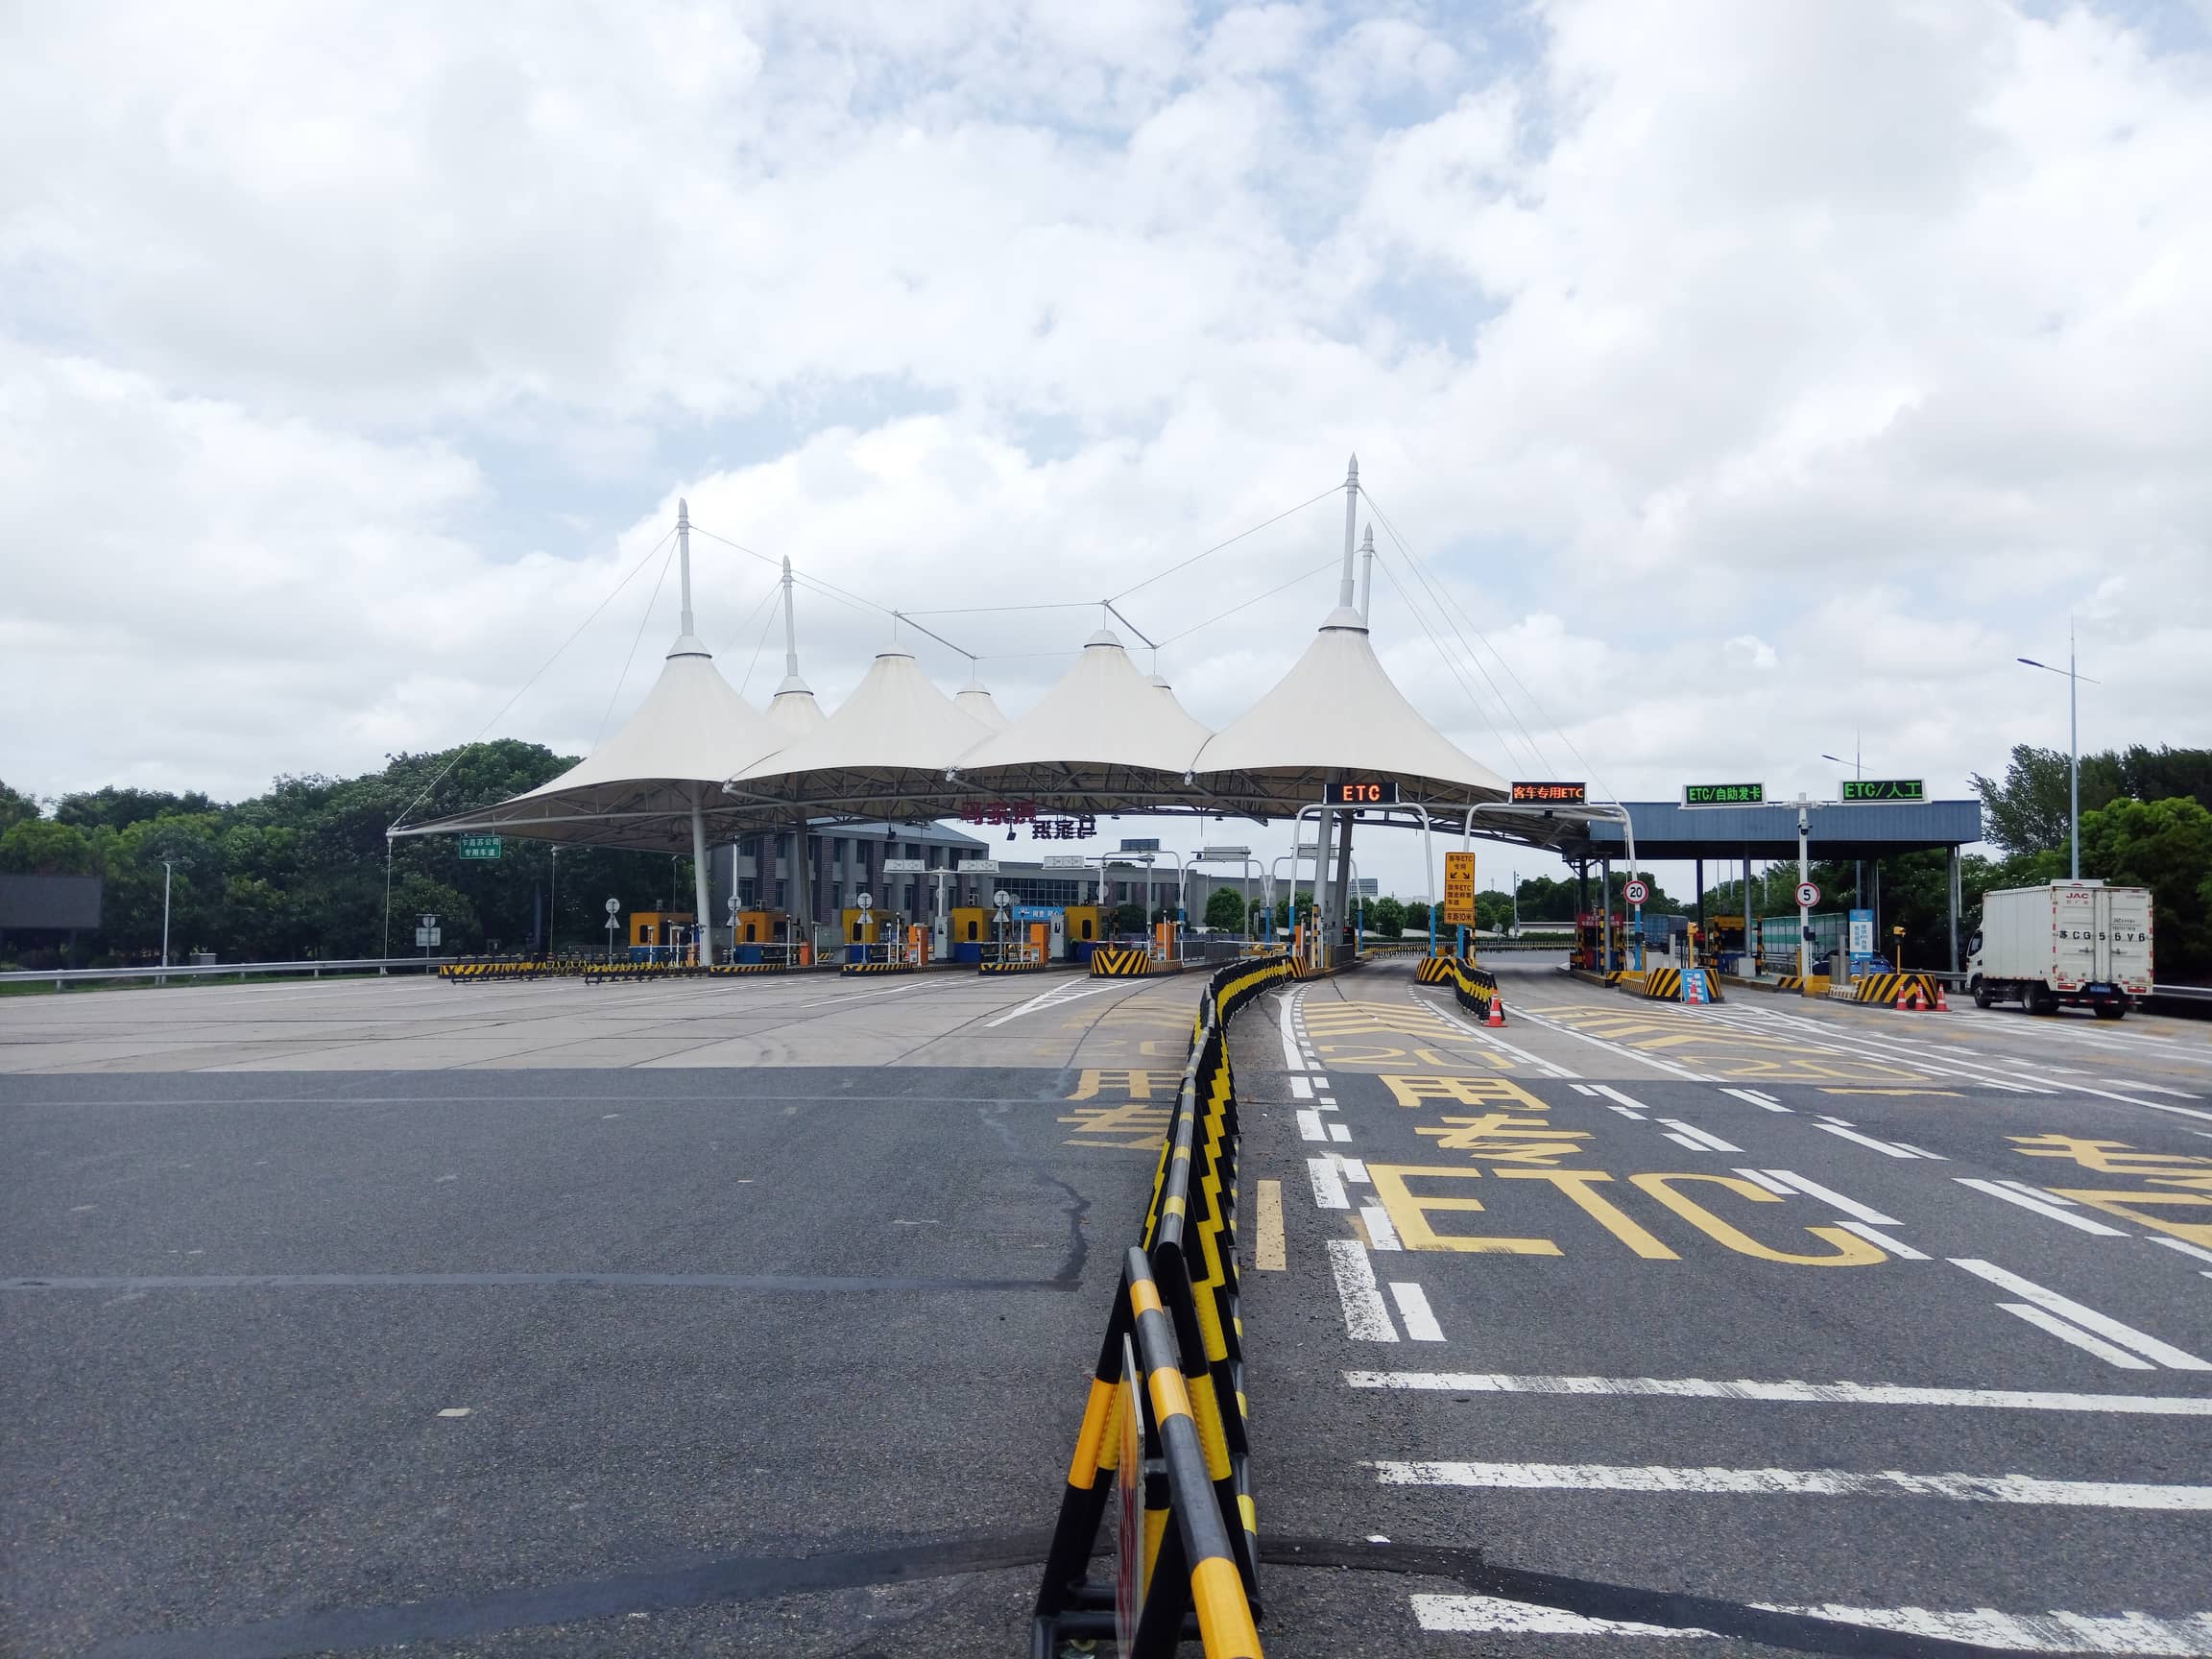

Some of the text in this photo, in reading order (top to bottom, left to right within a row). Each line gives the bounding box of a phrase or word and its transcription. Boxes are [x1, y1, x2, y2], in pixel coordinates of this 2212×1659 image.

[1343, 785, 1381, 802] ETC
[1513, 785, 1583, 800] 客车专用ETC
[1688, 786, 1761, 802] ETC/自助发卡
[1844, 782, 1921, 799] ETC/人工
[1629, 886, 1643, 898] 20
[1803, 889, 1811, 901] 5
[1318, 1046, 1517, 1069] 20
[1366, 1164, 1888, 1266] ETC
